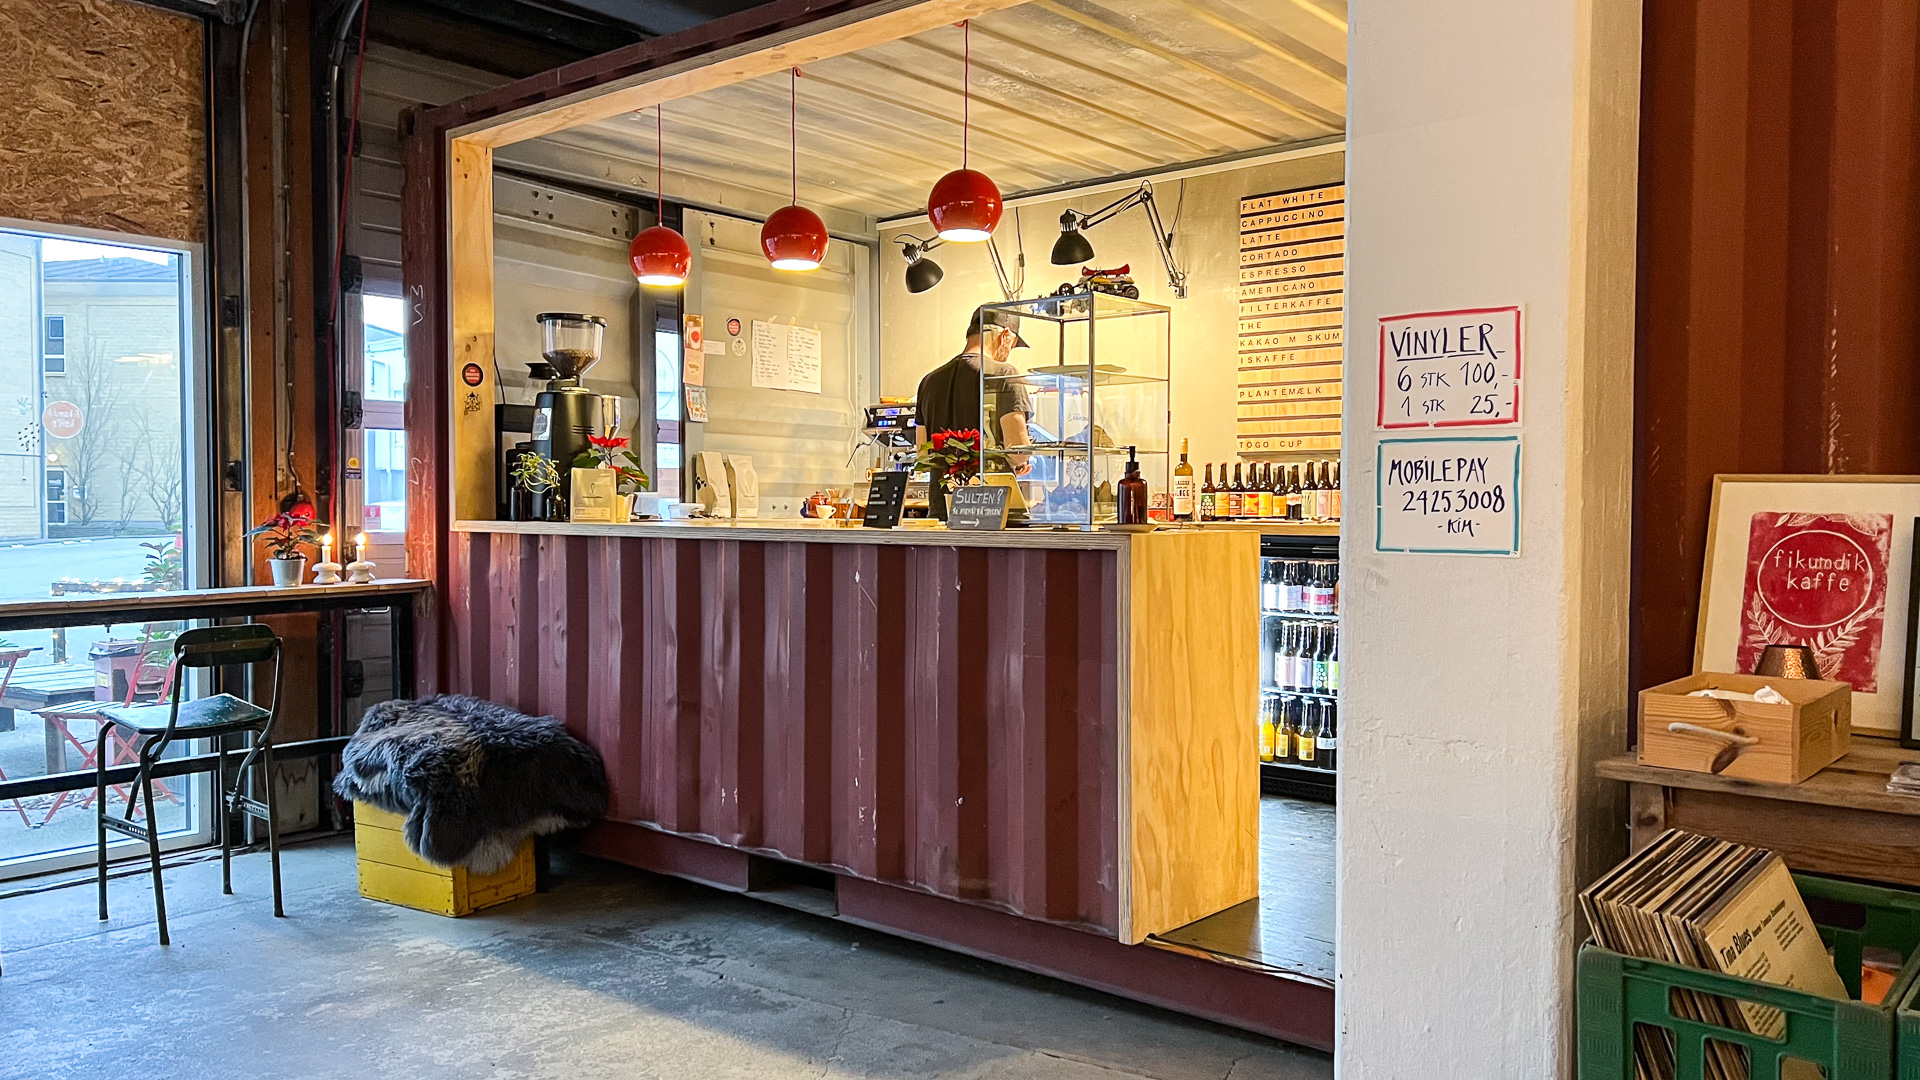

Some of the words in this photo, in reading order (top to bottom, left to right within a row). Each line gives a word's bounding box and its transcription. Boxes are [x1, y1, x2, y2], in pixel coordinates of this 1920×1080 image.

[1242, 199, 1272, 211] FLAT
[1282, 191, 1324, 204] WHITE
[1241, 209, 1324, 228] CAPPUCCINO
[1242, 233, 1280, 245] LATTE
[1241, 248, 1298, 262] CORTADO
[1241, 265, 1306, 279] ESPRESSO
[1241, 281, 1315, 296] AMERICANO
[1240, 297, 1331, 313] FILTERKAFFE
[1240, 321, 1262, 330] THE
[1239, 337, 1279, 347] KAKAO
[1288, 335, 1296, 343] M
[1307, 332, 1340, 342] SKUM
[1390, 323, 1498, 359] VINYLER
[1240, 353, 1295, 364] ISKAFFE
[1397, 365, 1412, 392] 6
[1420, 372, 1451, 388] STK
[1239, 386, 1322, 398] PLANTEMÆLK
[1401, 395, 1411, 417] 1
[1422, 399, 1446, 414] STK
[1279, 440, 1303, 448] CUP
[1402, 484, 1506, 515] 24253008
[1774, 549, 1865, 571] fikumdik
[1787, 570, 1849, 592] kaffe
